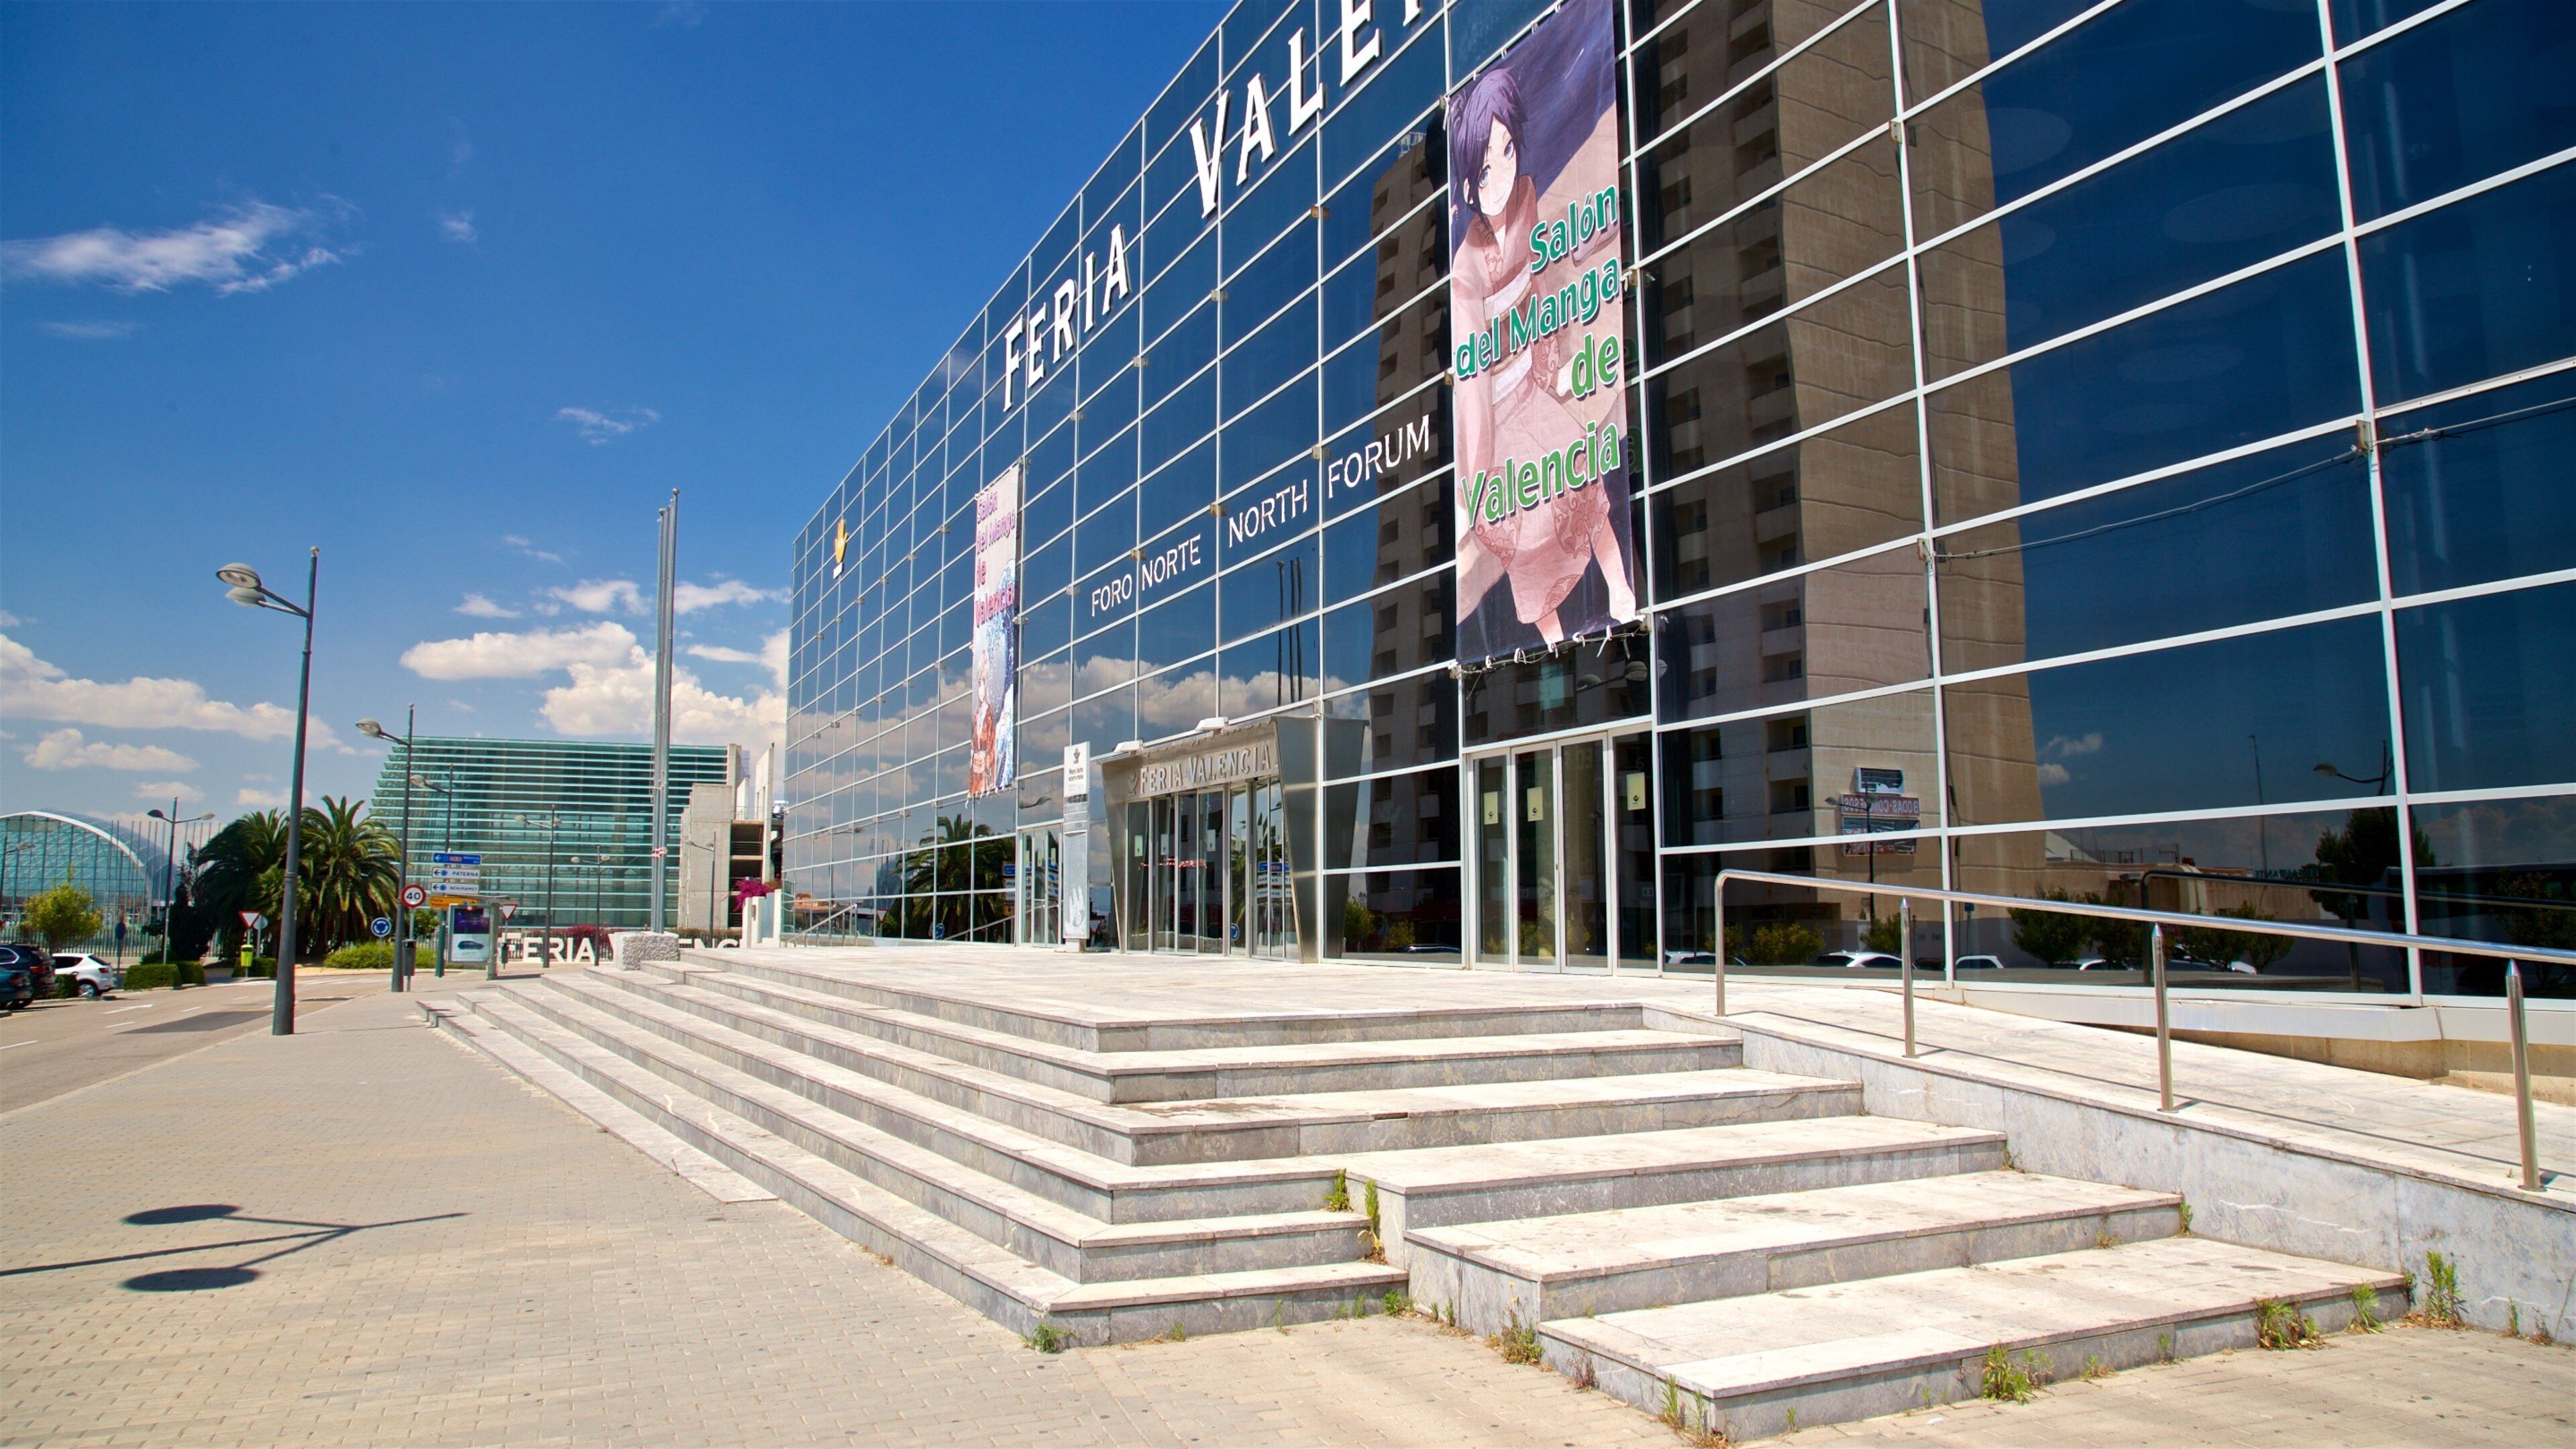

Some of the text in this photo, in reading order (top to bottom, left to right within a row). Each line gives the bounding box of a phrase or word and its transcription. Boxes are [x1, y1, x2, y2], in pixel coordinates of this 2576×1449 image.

[1003, 0, 1421, 413] FERIA VALE
[1529, 184, 1619, 274] Salón
[1456, 256, 1620, 379] del Manga
[1570, 331, 1621, 399] de
[1460, 419, 1621, 529] Valencia
[976, 508, 1016, 555] del Manga
[977, 491, 998, 525] Salón
[1091, 414, 1430, 617] FORO NORTE NORTH FORUM
[976, 559, 986, 588] de
[975, 582, 1014, 628] Valencia
[1140, 763, 1183, 794] FERIA
[406, 892, 421, 900] 40
[500, 932, 596, 963] FERIA
